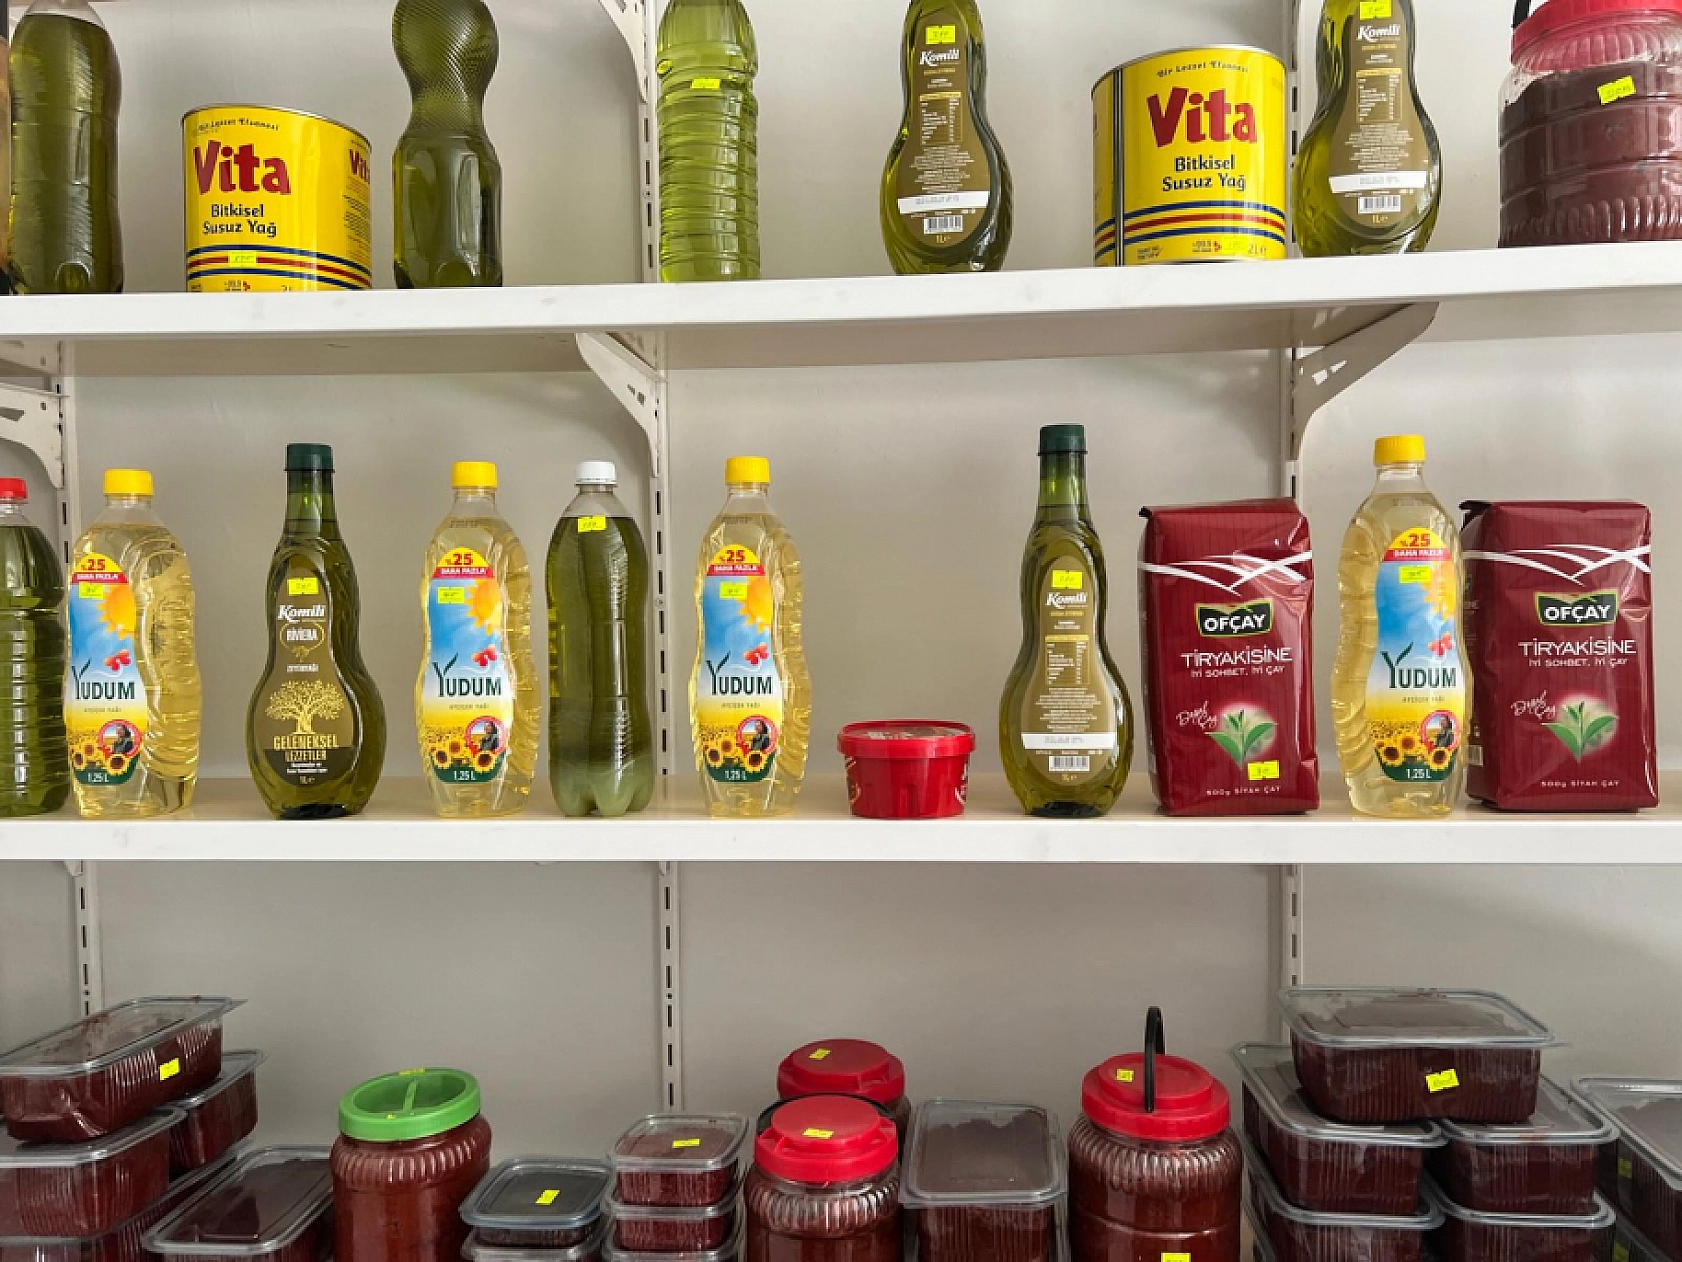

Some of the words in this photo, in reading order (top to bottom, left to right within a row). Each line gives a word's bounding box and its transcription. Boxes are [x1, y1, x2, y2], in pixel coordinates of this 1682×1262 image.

[1146, 86, 1258, 148] Vita
[193, 140, 292, 195] Vita
[1174, 154, 1236, 172] Bitkisel
[1162, 176, 1213, 192] Susuz
[1218, 172, 1247, 192] Yağ
[211, 203, 264, 218] Bitkisel
[203, 220, 242, 235] Susuz
[247, 219, 277, 238] Yağ
[1204, 613, 1266, 634] OFÇAY
[1544, 604, 1611, 623] OFÇAY
[1181, 643, 1293, 668] TİRYAKİSİNE
[1517, 635, 1637, 656] TİRYAKİSİNE
[432, 652, 502, 698] YUDUM
[706, 650, 772, 696] YUDUM
[1380, 641, 1457, 689] YUDUM
[71, 658, 135, 700] YUDUM
[273, 734, 339, 750] GELENEKSEL
